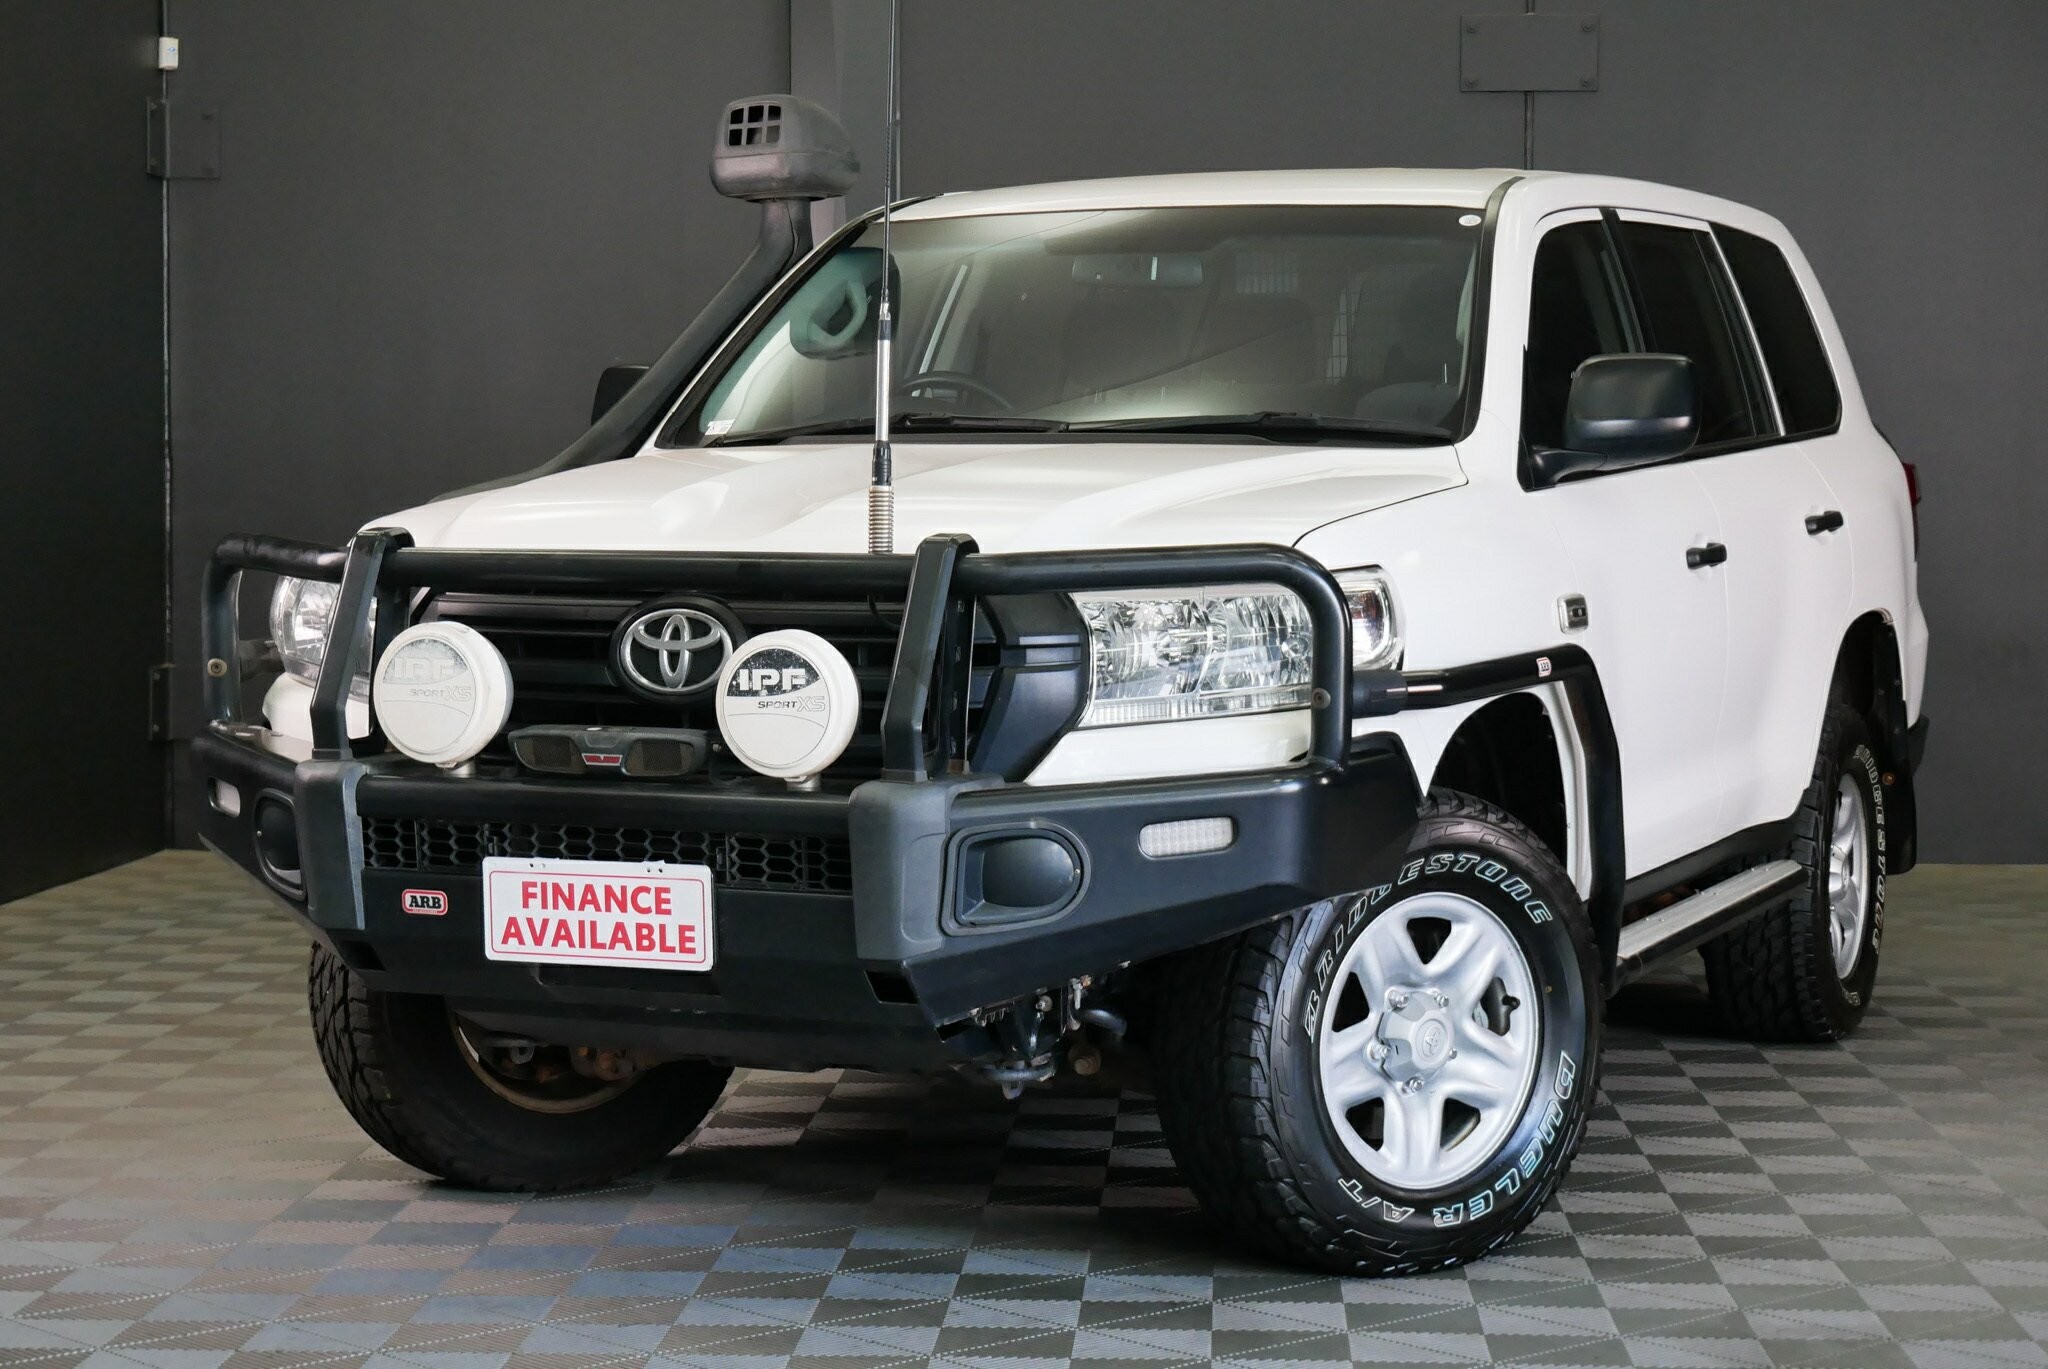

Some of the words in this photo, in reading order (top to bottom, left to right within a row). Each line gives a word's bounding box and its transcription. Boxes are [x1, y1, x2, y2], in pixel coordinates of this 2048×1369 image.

[393, 657, 455, 680] IPF
[739, 668, 806, 691] IPF
[408, 894, 442, 910] ARB
[521, 881, 672, 916] FINANCE
[501, 916, 697, 955] AVAILABLE
[1433, 1050, 1576, 1227] DUELER
[1337, 1176, 1415, 1224] A/T
